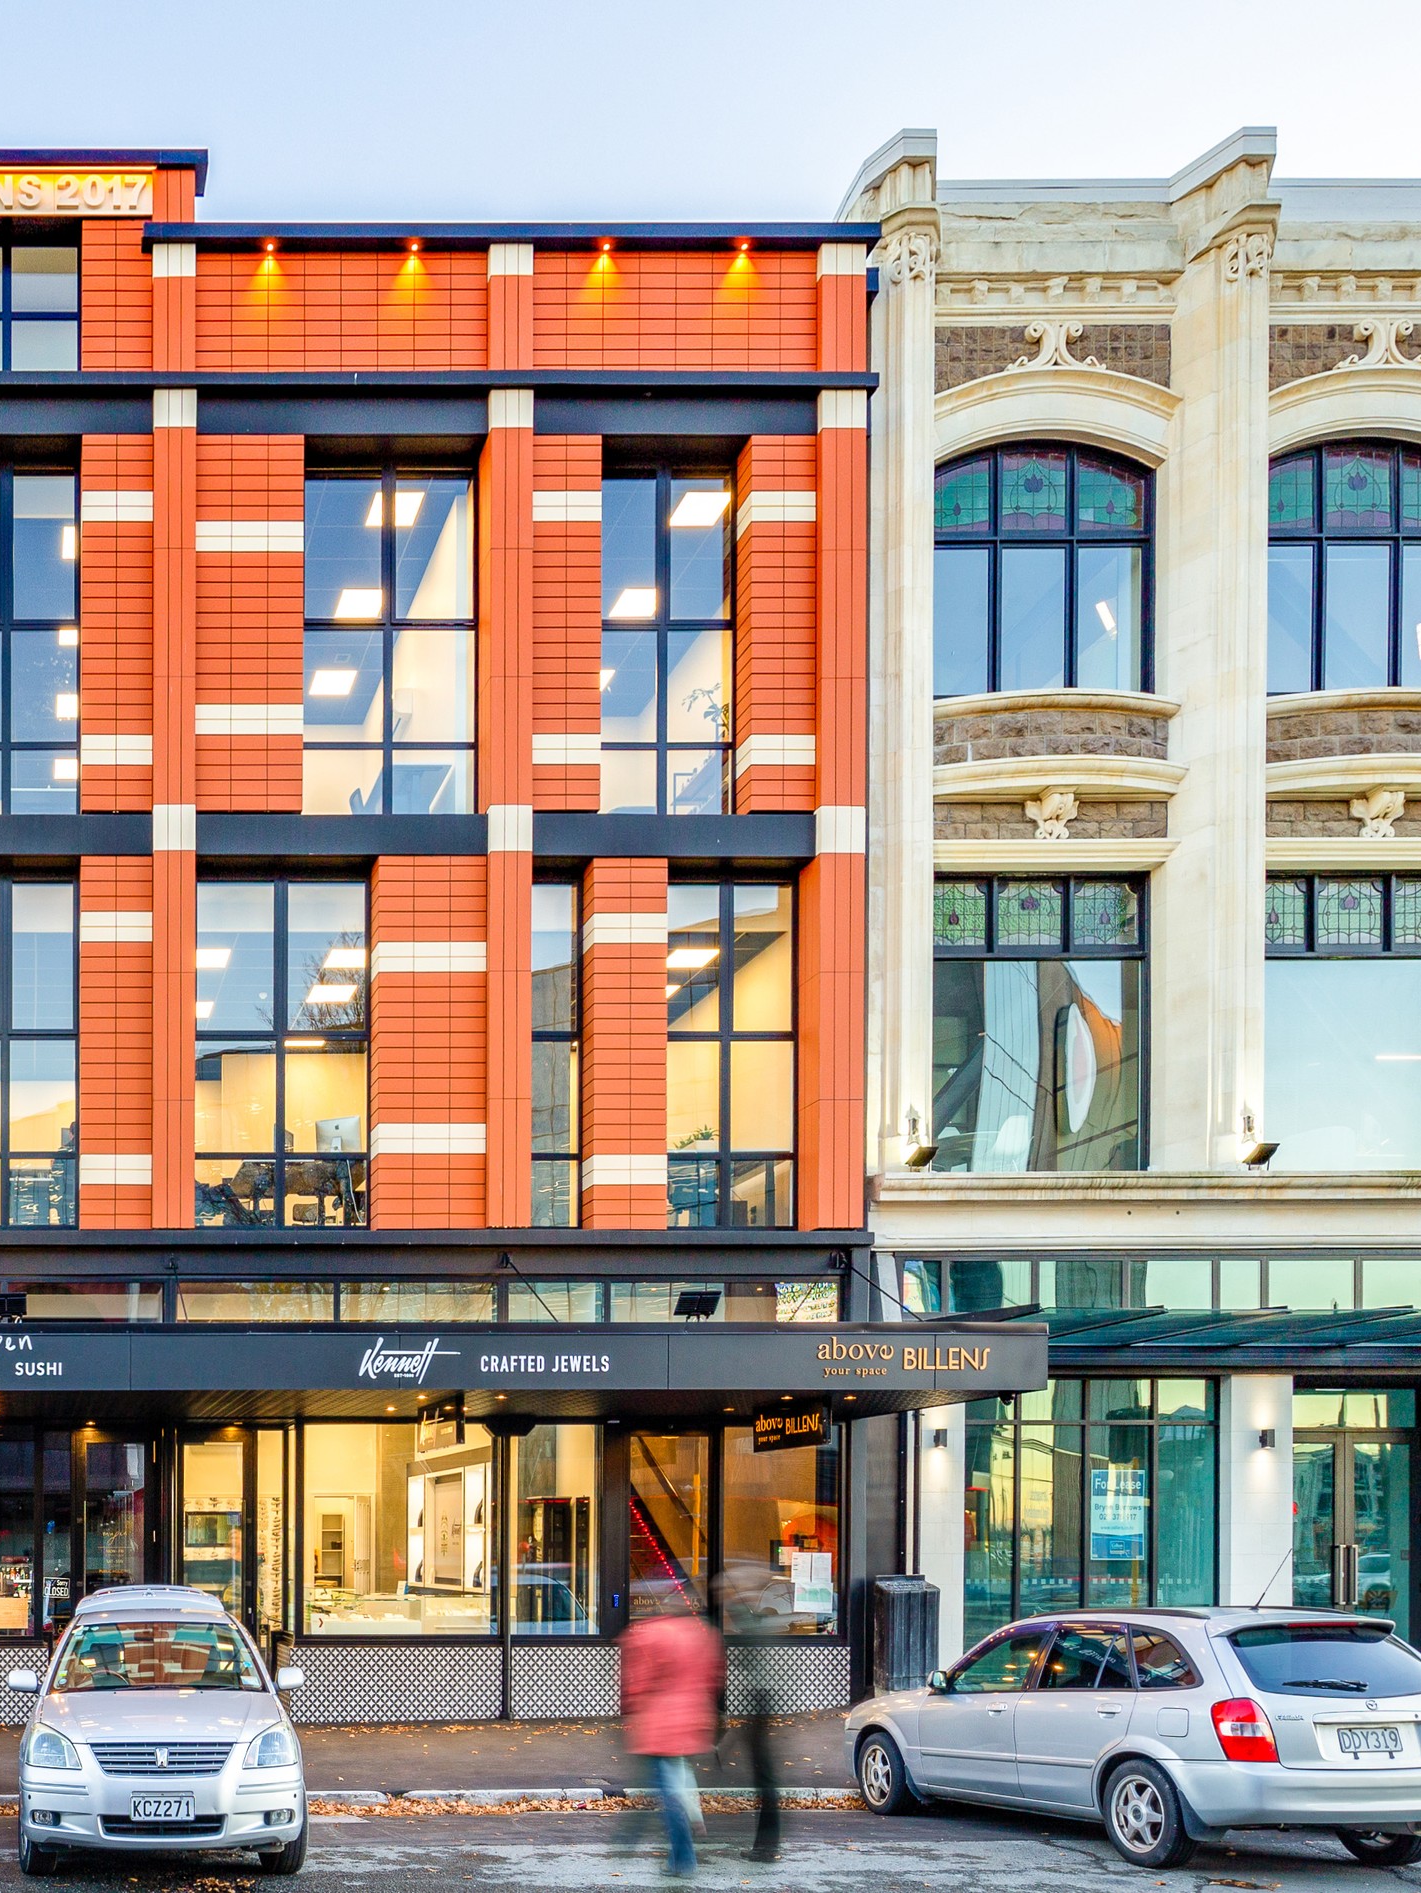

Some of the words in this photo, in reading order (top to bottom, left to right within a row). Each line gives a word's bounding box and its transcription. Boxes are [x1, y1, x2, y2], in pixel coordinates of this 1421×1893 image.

[55, 174, 148, 210] 2017
[358, 1336, 462, 1385] Kennett
[816, 1336, 895, 1361] above
[902, 1347, 991, 1371] BILLENS
[14, 1361, 63, 1376] SUSHI
[479, 1355, 546, 1373] CRAFTED
[551, 1355, 611, 1373] JEWELS
[823, 1366, 851, 1378] your
[855, 1365, 888, 1378] space
[755, 1414, 784, 1433] above
[785, 1413, 820, 1435] BILLENS
[1094, 1478, 1110, 1490] Fo
[44, 1587, 69, 1596] CLOSED
[56, 1579, 68, 1587] Sorry
[1340, 1730, 1399, 1750] DDY319
[133, 1800, 191, 1818] KCZ271
